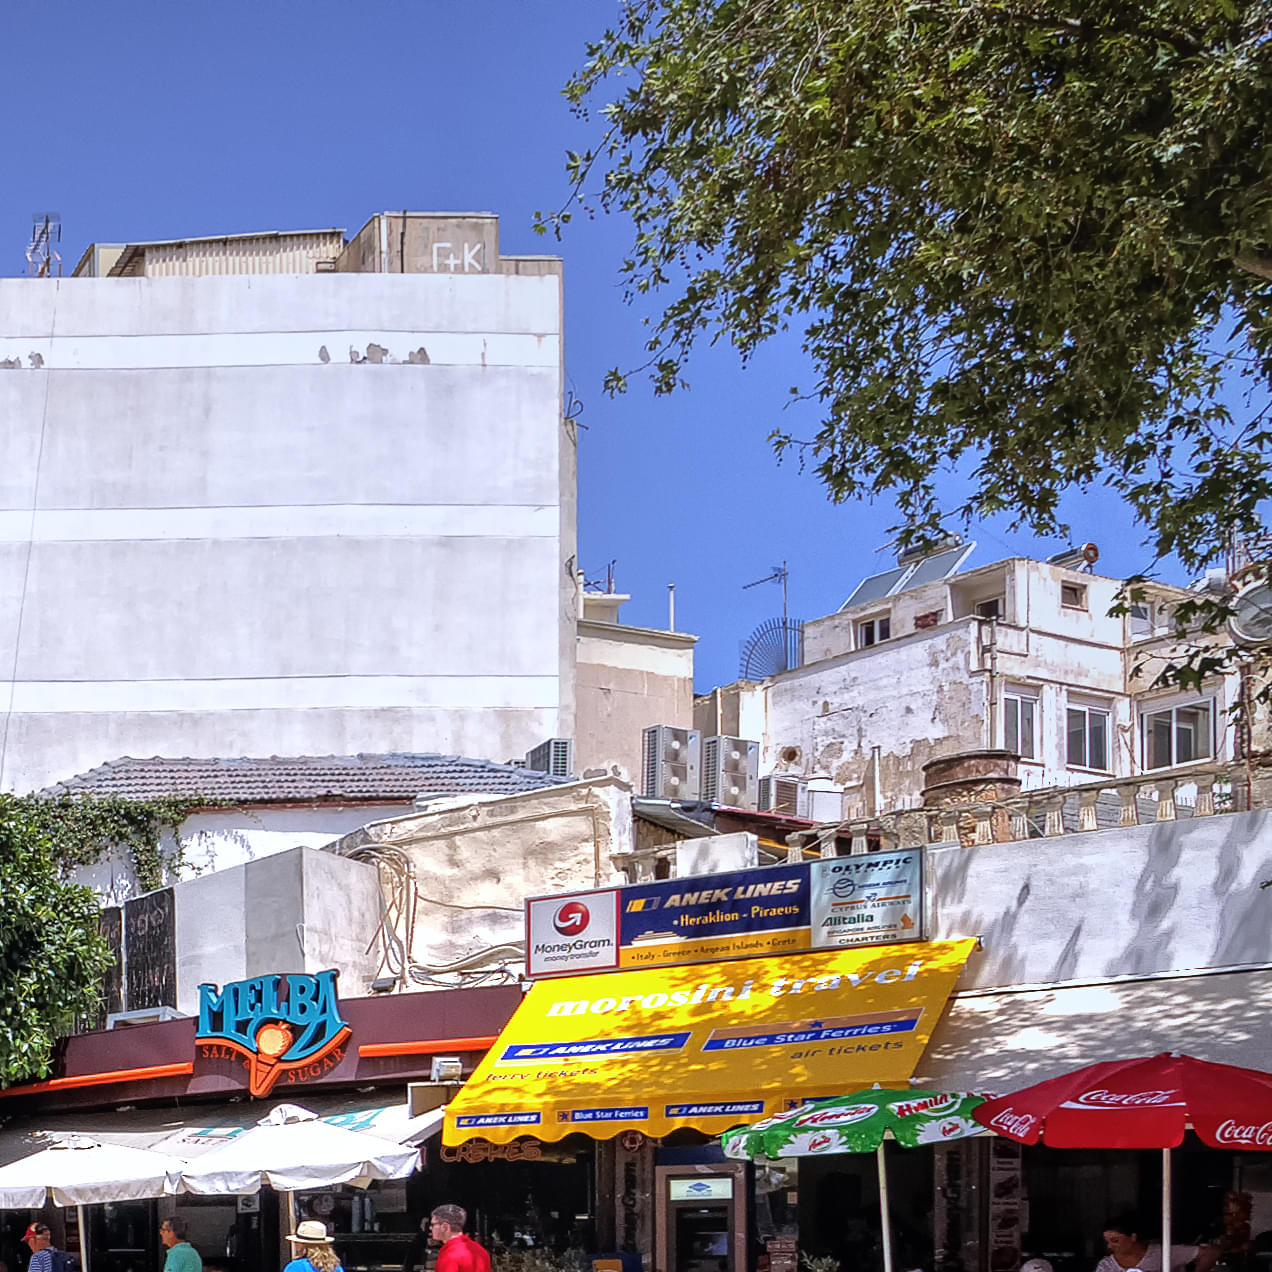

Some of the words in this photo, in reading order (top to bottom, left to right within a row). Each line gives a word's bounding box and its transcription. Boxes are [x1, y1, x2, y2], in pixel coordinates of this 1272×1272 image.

[831, 856, 913, 873] OLYMPIC
[662, 886, 733, 909] ANEK
[734, 877, 802, 904] LINES
[680, 909, 740, 927] Heraklion
[751, 904, 800, 920] Piraeus
[821, 913, 874, 928] Alitalia
[534, 938, 612, 955] MoneyGram
[838, 933, 897, 945] CHARTERS
[545, 979, 755, 1018] morosini
[769, 960, 924, 998] travel
[195, 969, 350, 1061] MELBA
[723, 1035, 773, 1049] Blue
[775, 1031, 816, 1044] Star
[819, 1023, 894, 1040] Ferries
[549, 1042, 609, 1056] ANEK
[611, 1037, 675, 1051] LINES
[790, 1047, 822, 1060] air
[827, 1039, 905, 1056] tickets
[202, 1045, 239, 1062] SALT
[287, 1047, 348, 1084] SUGAR
[574, 1109, 594, 1121] Blue
[596, 1108, 612, 1120] Star
[614, 1107, 646, 1120] Ferries
[688, 1103, 724, 1114] ANEK
[724, 1102, 760, 1113] LINES
[476, 1114, 507, 1125] ANEK
[507, 1113, 538, 1124] LINES
